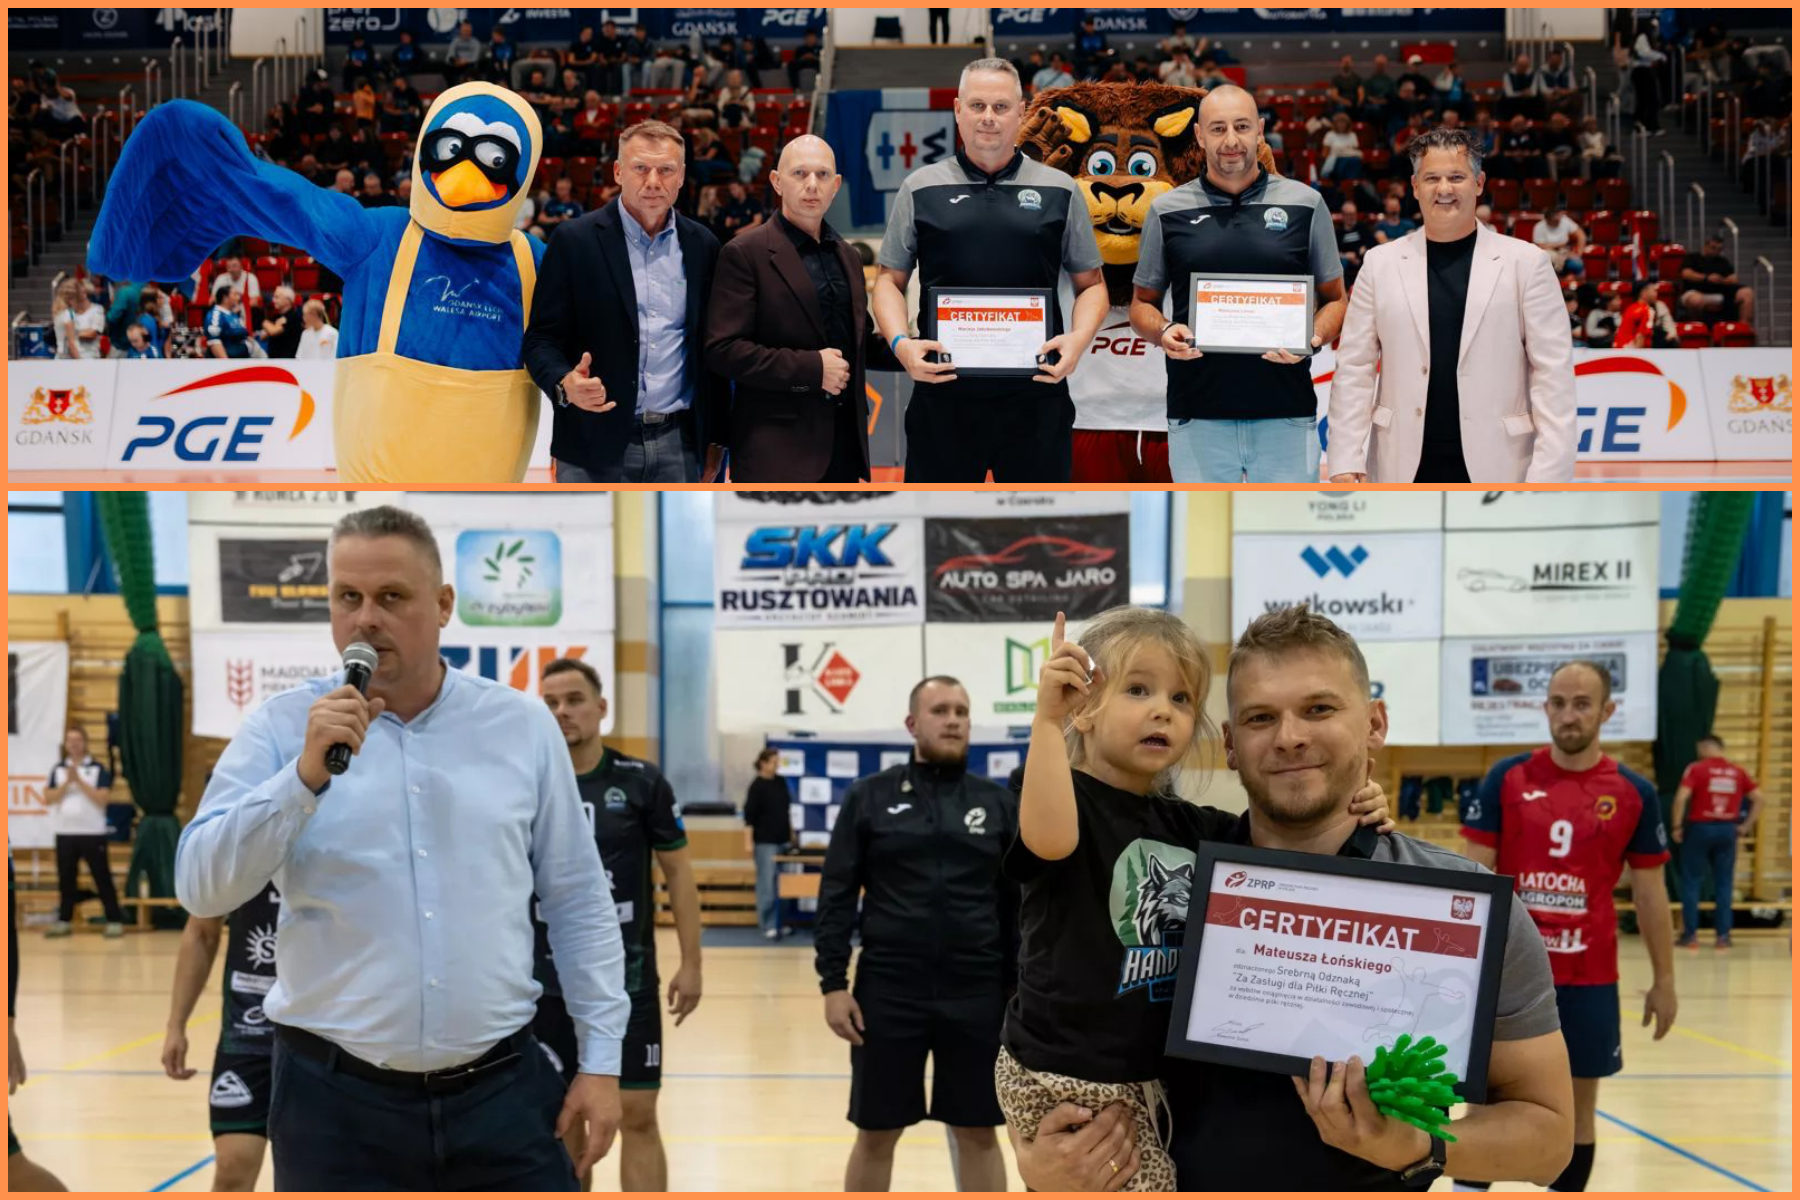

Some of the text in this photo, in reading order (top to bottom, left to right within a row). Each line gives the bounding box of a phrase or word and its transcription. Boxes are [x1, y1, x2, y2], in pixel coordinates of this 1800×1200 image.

[328, 15, 381, 31] zero
[762, 9, 810, 26] PGE
[997, 8, 1044, 23] PGE
[1092, 17, 1148, 31] DAŃSK
[1210, 295, 1283, 306] CERTYFIKAT
[950, 311, 1022, 322] CERTYFIKAT
[1091, 336, 1147, 356] PGE
[121, 416, 275, 461] PGE
[740, 523, 899, 570] SKK
[940, 567, 1117, 590] AUTO SPA JARO
[1533, 560, 1632, 582] MIREX II
[721, 586, 918, 611] RUSZTOWANIA
[1549, 820, 1574, 858] 9
[1247, 878, 1276, 890] ZPRP
[1519, 871, 1585, 893] LATOCHA
[1239, 907, 1420, 951] CERTYFIKAT
[1253, 943, 1318, 963] Mateusza
[1320, 953, 1392, 975] Łońskiego
[1250, 975, 1286, 990] Zasługi
[1288, 981, 1303, 991] dla
[1306, 982, 1328, 994] Piłki
[1277, 966, 1316, 981] Srebrną
[1318, 971, 1361, 987] Odznaką
[644, 1043, 660, 1067] 10
